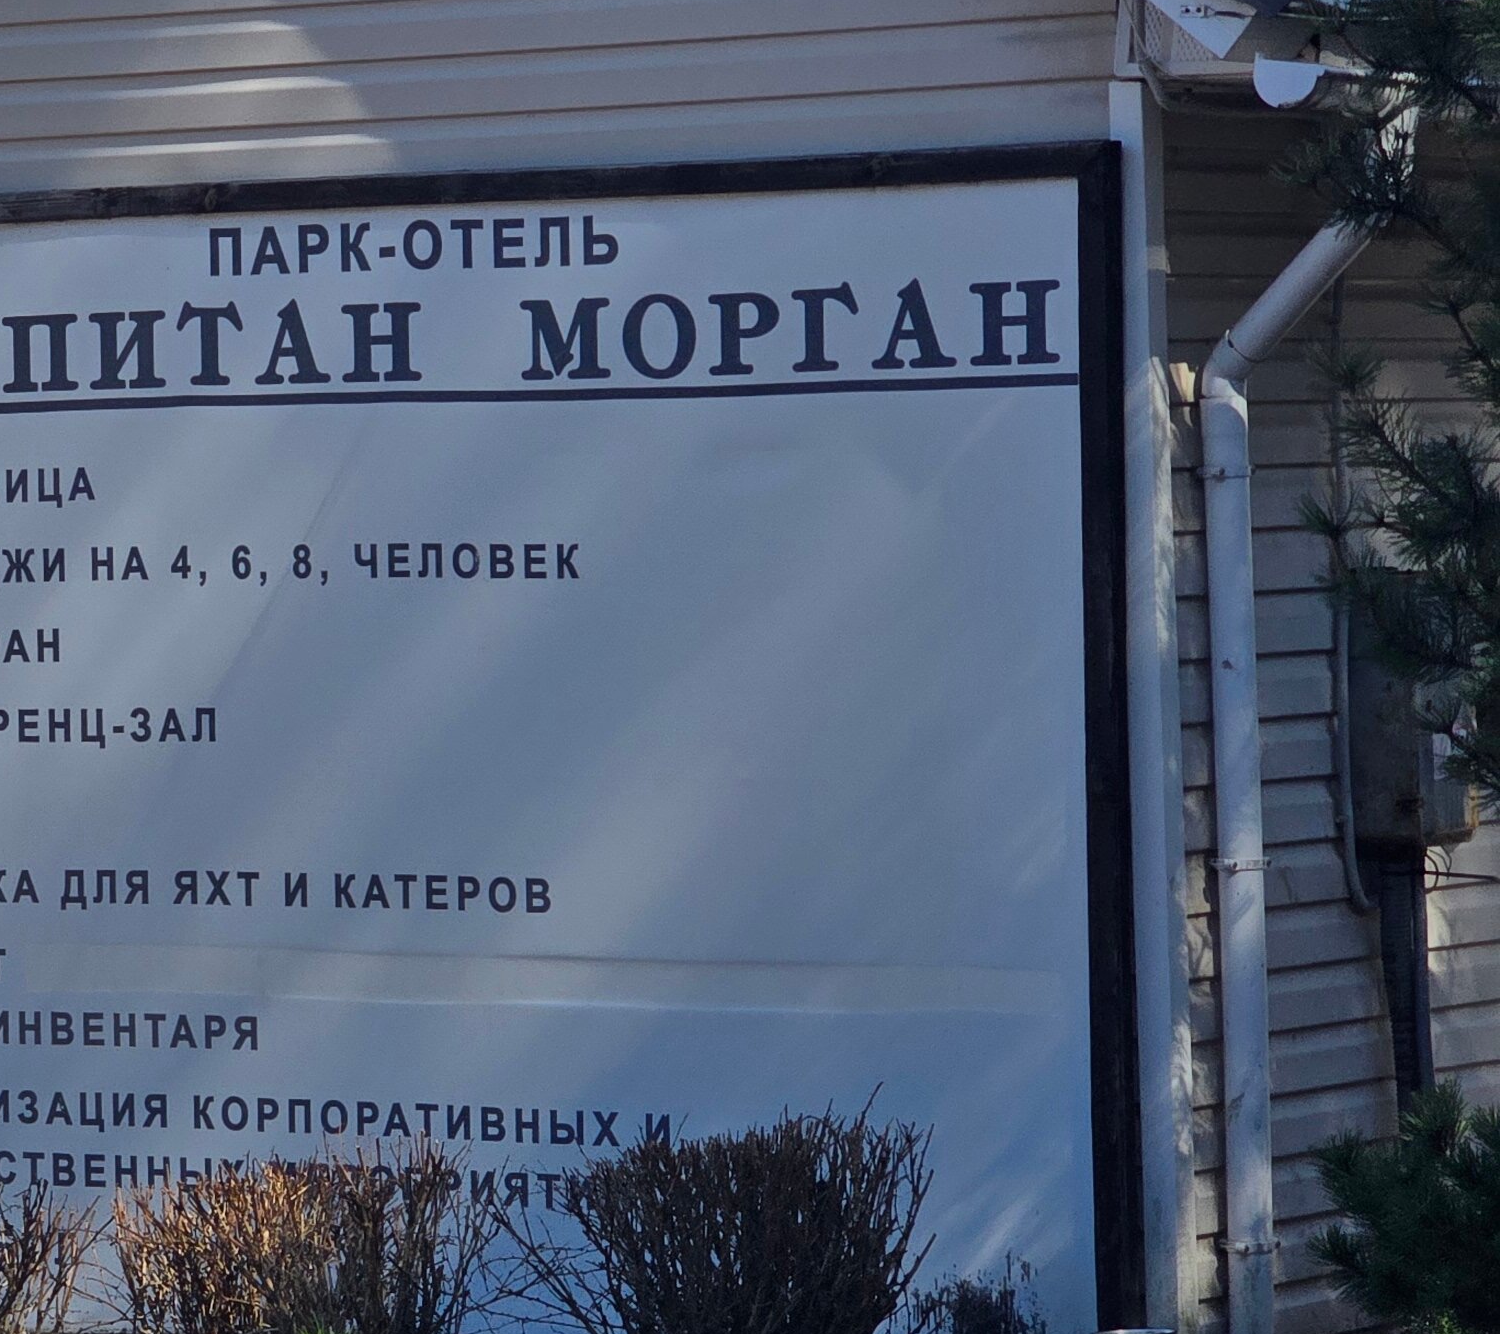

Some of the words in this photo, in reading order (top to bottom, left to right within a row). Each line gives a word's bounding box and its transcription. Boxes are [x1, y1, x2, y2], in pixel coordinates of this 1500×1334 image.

[206, 215, 620, 278] ПАРК-ОТЕЛЬ
[520, 278, 1062, 384] МОРГАН
[91, 547, 148, 581] НА
[354, 543, 579, 579] ЧЕЛОВЕК
[61, 870, 148, 910] ДЛЯ
[173, 871, 259, 906] ЯХТ
[285, 873, 307, 907] И
[335, 873, 550, 913] КАТЕРОВ
[192, 1093, 621, 1147] КОРПОРАТИВНЫХ
